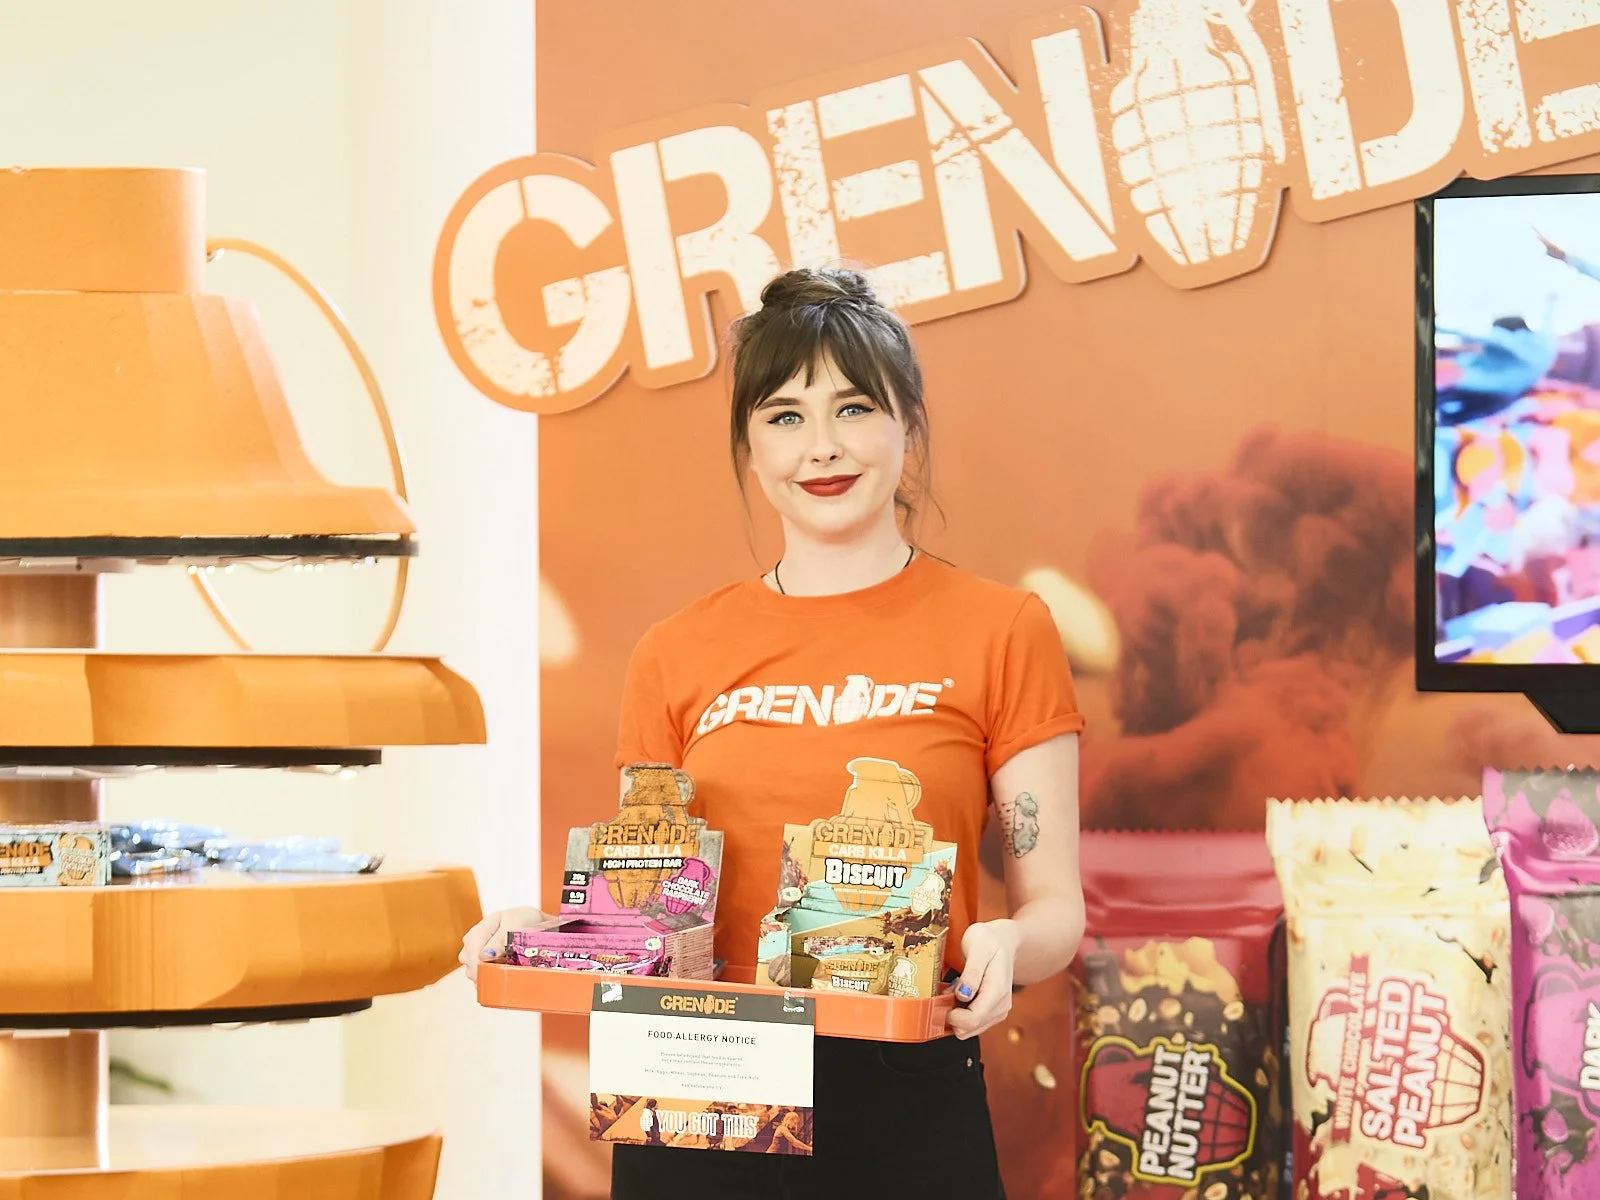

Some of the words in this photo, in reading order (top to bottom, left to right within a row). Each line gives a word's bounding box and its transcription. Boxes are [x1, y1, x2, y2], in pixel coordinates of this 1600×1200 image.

[603, 845, 641, 858] CARB
[643, 845, 682, 857] KILLA
[603, 860, 625, 869] HIGH
[626, 859, 662, 869] PROTEIN
[663, 858, 682, 868] BAR
[829, 845, 866, 859] CARB
[869, 847, 907, 861] KILLA
[661, 880, 711, 899] CHOCOLATE
[677, 876, 700, 889] DARK
[1343, 971, 1366, 1072] CHOCOLATE
[647, 1030, 673, 1040] FOOD
[675, 1032, 719, 1043] ALLERGY
[721, 1034, 757, 1045] NOTICE
[1361, 981, 1410, 1140] SALTED
[1393, 984, 1446, 1148] PEANUT
[1139, 1045, 1181, 1176] PEANUT
[1167, 1048, 1211, 1180] NUTTER
[1333, 1074, 1357, 1130] WHITE
[656, 1110, 687, 1134] YOU
[688, 1111, 719, 1137] GOT
[721, 1114, 759, 1138] THIS
